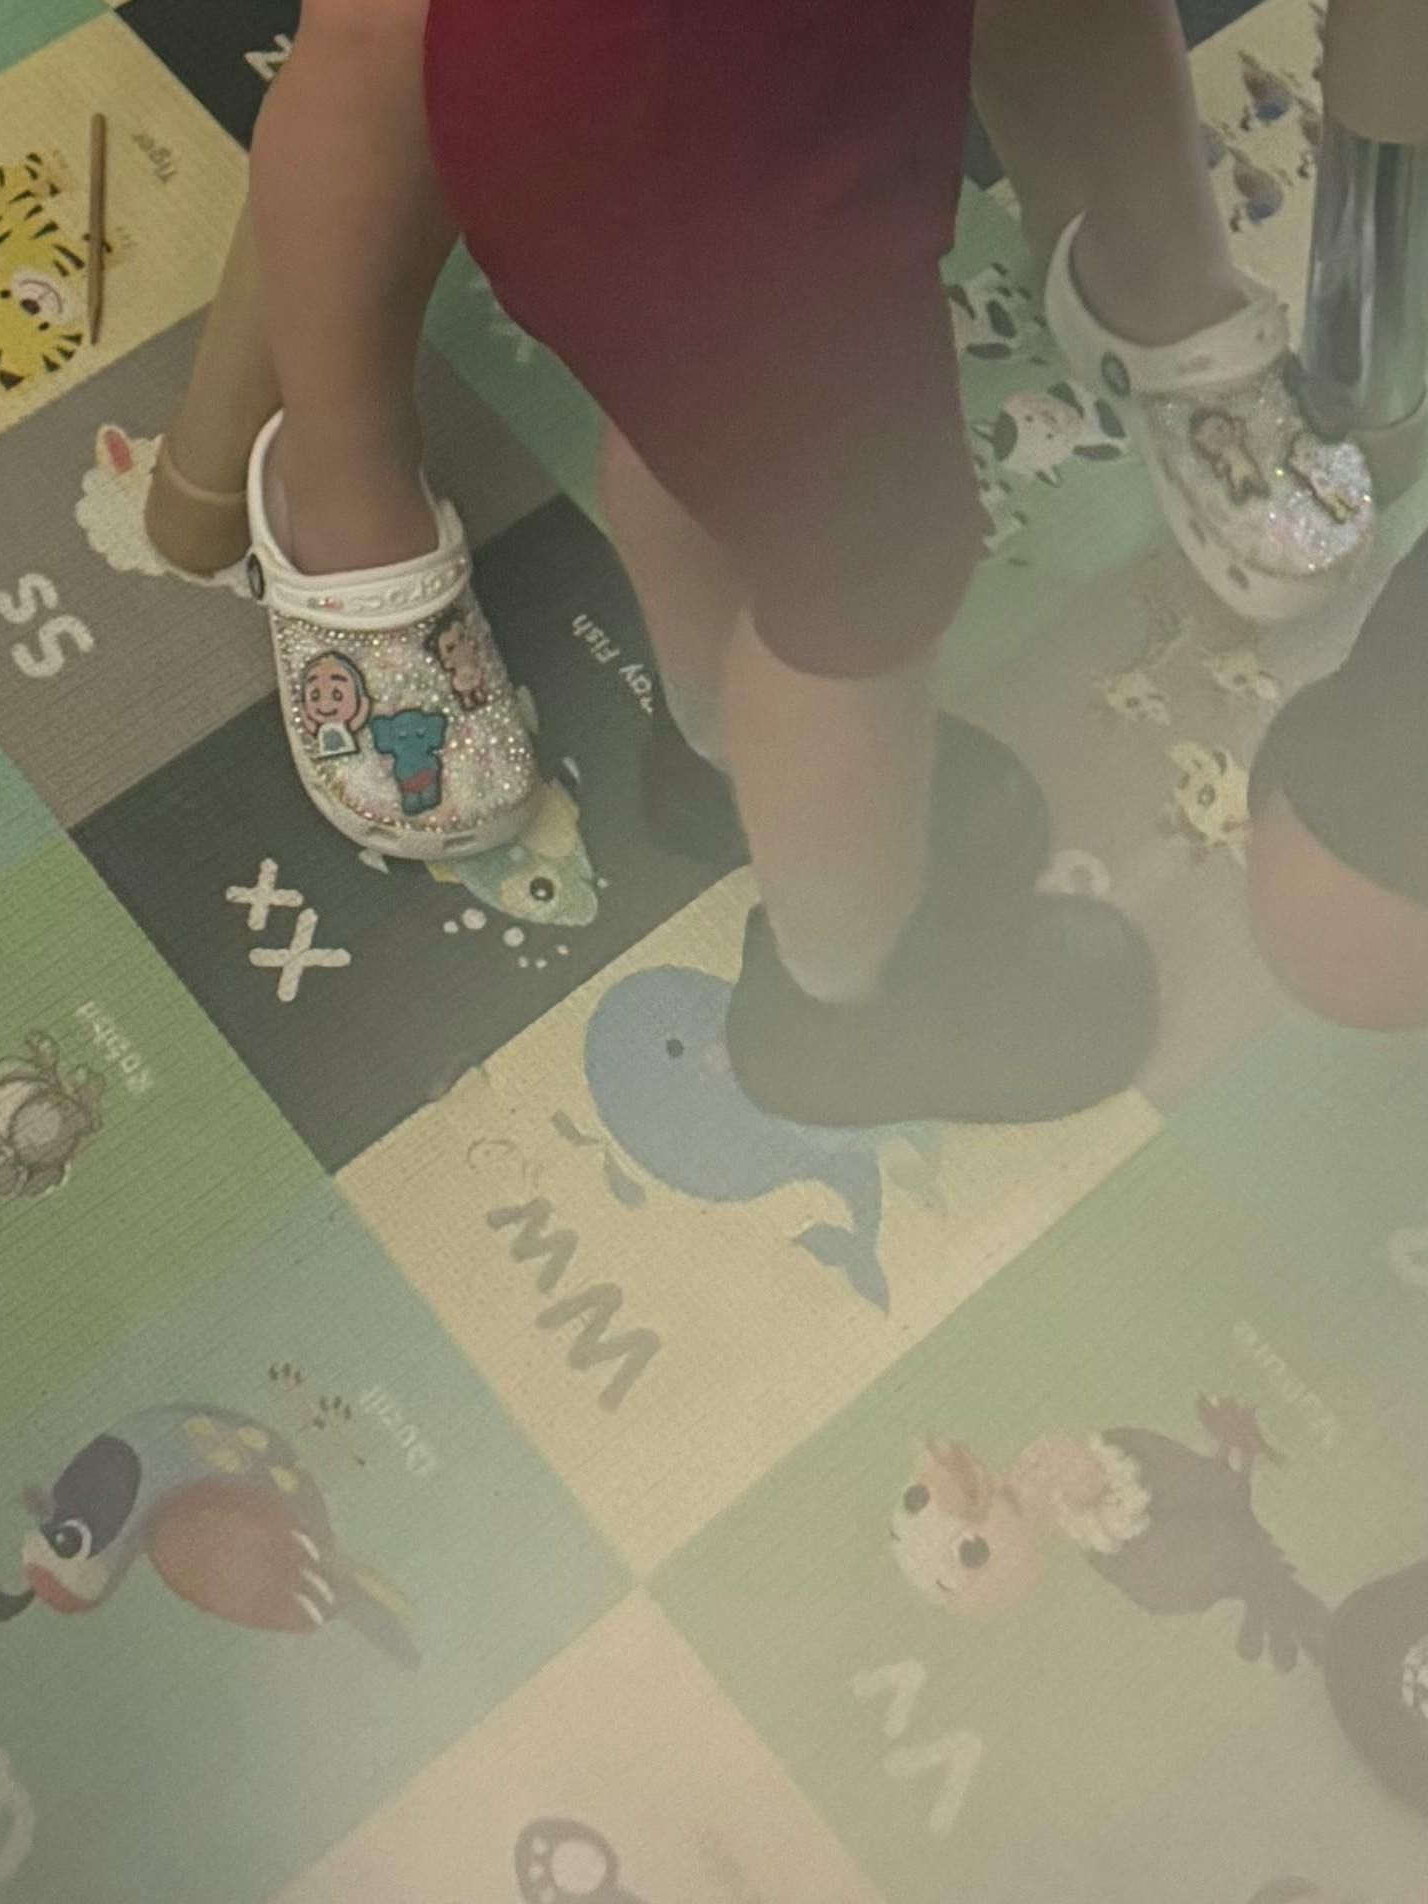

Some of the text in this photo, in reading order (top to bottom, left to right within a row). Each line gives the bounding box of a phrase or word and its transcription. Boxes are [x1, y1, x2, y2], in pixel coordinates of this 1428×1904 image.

[571, 613, 620, 664] Fish
[225, 859, 352, 1002] Xx
[487, 1197, 662, 1412] Ww
[853, 1656, 982, 1834] Vv
